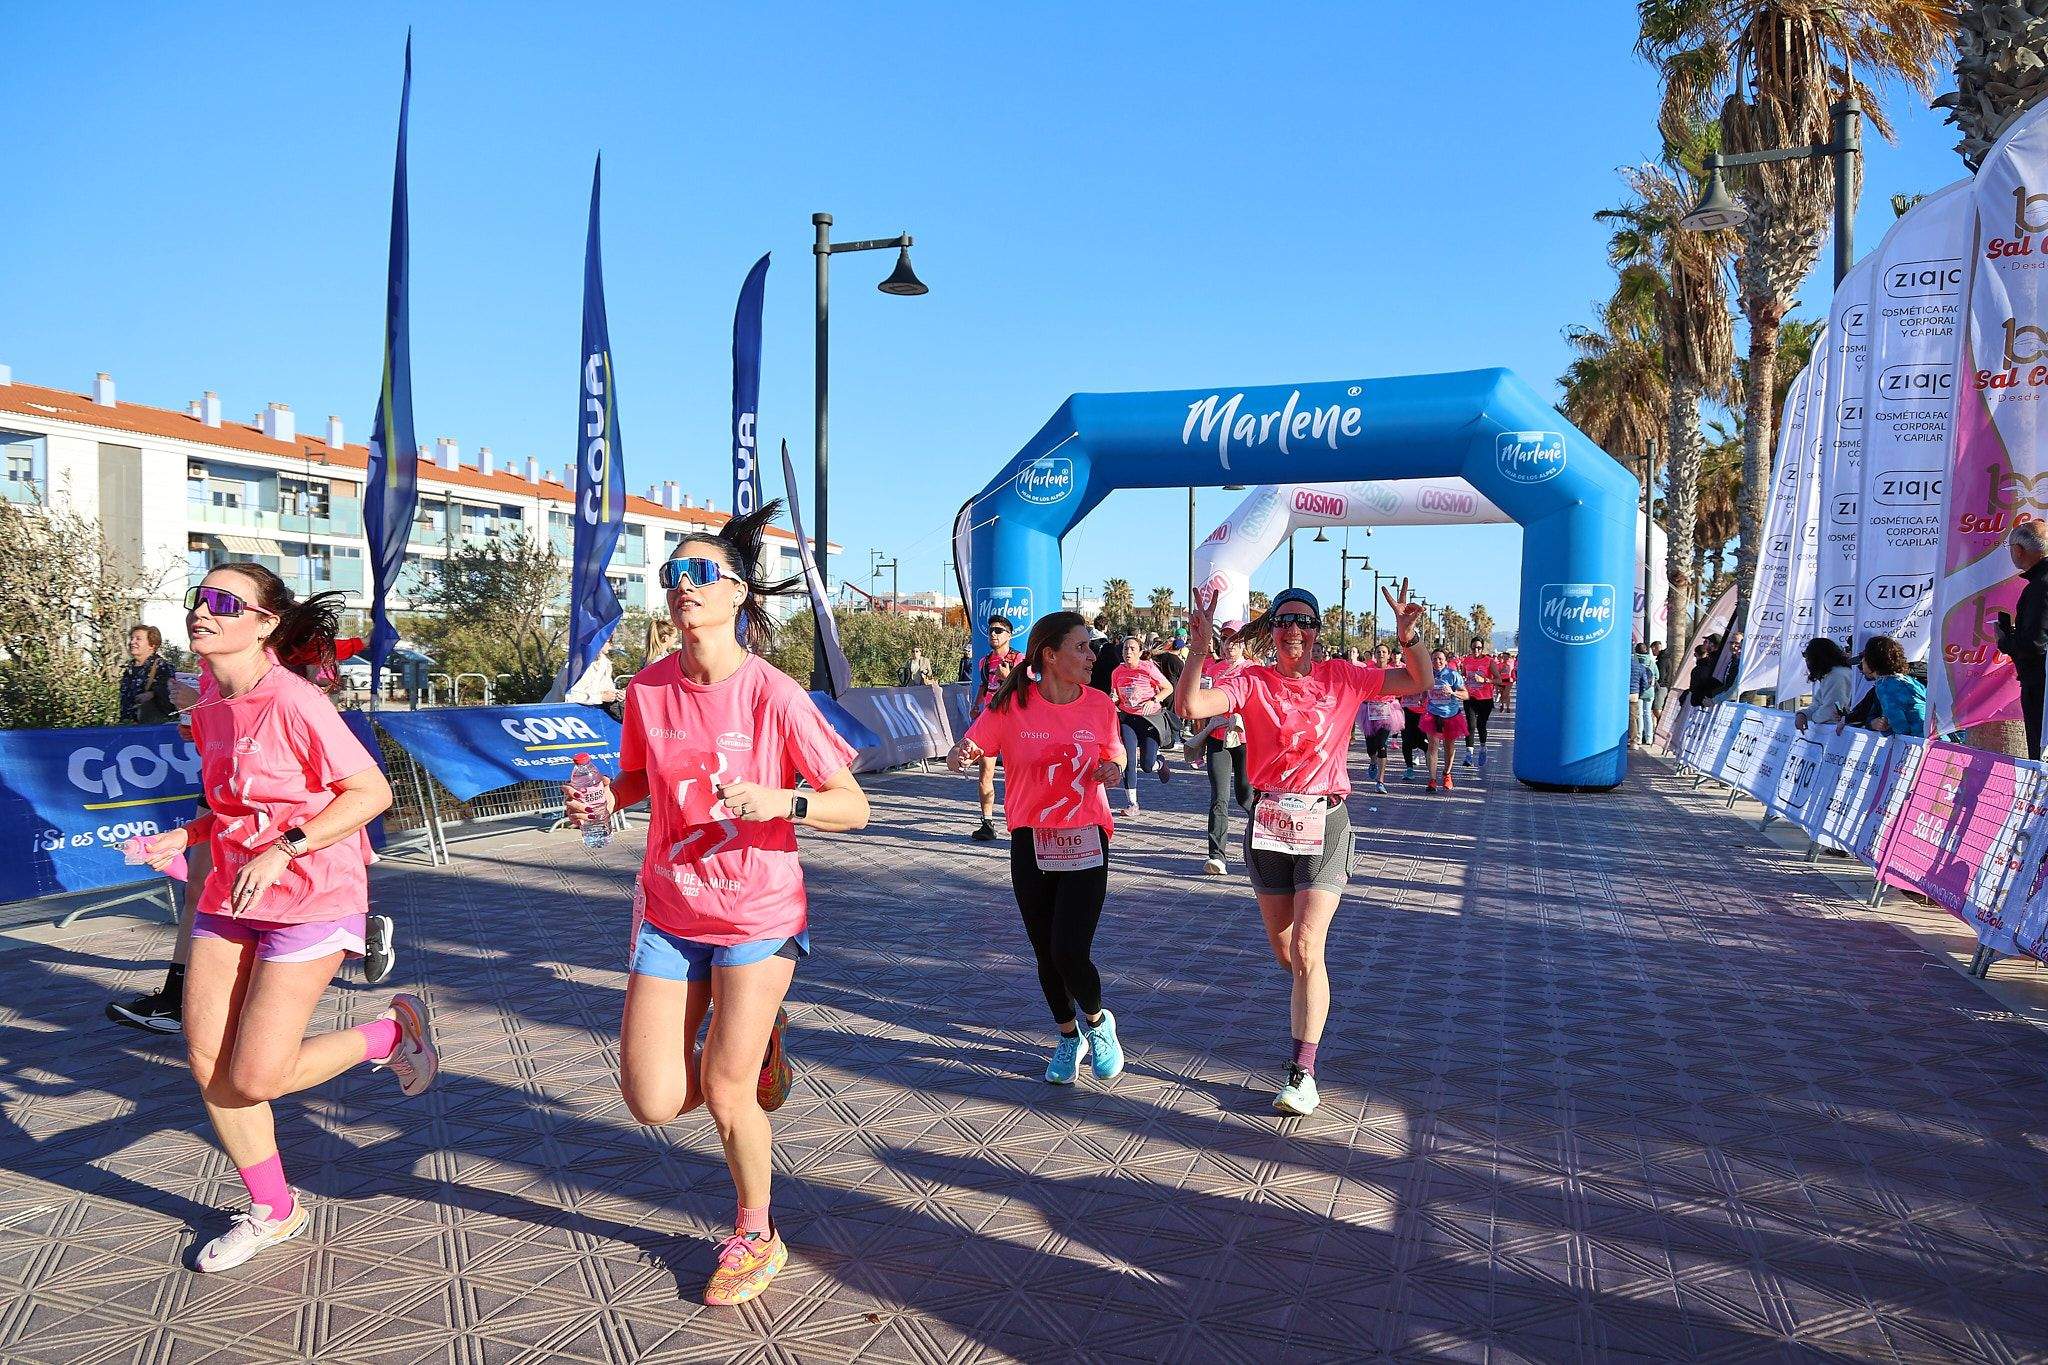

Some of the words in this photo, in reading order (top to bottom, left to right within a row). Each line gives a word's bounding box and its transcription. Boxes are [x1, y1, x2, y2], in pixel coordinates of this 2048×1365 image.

[1986, 236, 2033, 259] Sal
[1900, 317, 1955, 327] CORPORAL
[1902, 330, 1908, 338] Y
[1910, 328, 1953, 338] CAPILAR
[1975, 367, 2021, 391] Sal
[1182, 389, 1362, 470] Marlene
[1893, 422, 1946, 431] CORPORAL
[1894, 434, 1901, 442] Y
[1903, 433, 1943, 442] CAPILAR
[737, 412, 755, 518] OYA
[1501, 442, 1562, 470] Marlene
[1020, 468, 1069, 491] Marlene
[1295, 491, 1344, 516] COSMO
[1422, 490, 1473, 514] COSMO
[1958, 512, 2006, 533] Sal
[1895, 538, 1939, 547] CAPILAR
[1544, 596, 1611, 627] Marlene
[1585, 628, 1605, 641] ALPES
[1943, 644, 1988, 665] Sal
[500, 716, 601, 744] GOYA
[649, 727, 687, 740] OYSHO
[1020, 731, 1050, 740] OYSHO
[67, 743, 202, 799] GOY
[71, 831, 94, 848] es
[96, 820, 159, 843] GOYA
[1279, 820, 1304, 832] 016
[1056, 835, 1082, 847] 016
[684, 873, 696, 885] DE
[710, 877, 740, 891] MUJER
